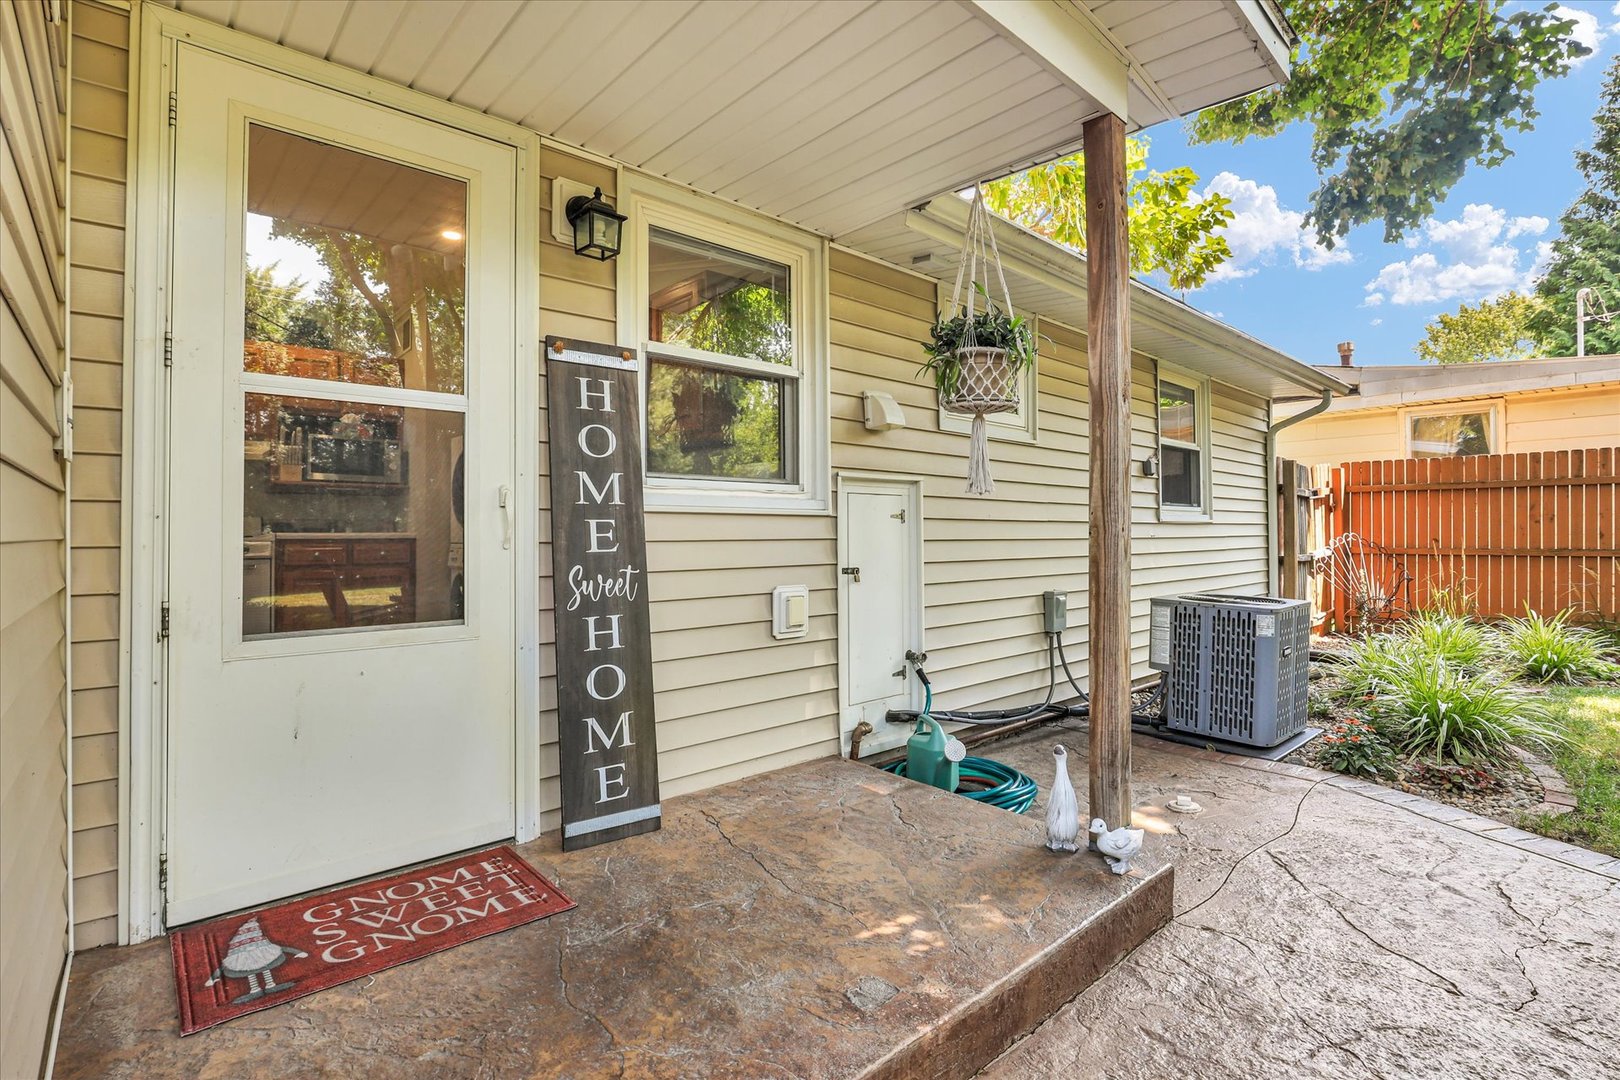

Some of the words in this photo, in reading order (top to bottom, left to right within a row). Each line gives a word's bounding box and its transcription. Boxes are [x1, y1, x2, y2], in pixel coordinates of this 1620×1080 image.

[574, 376, 625, 553] HOME
[567, 565, 640, 611] Sweet
[583, 614, 635, 804] HOME
[303, 857, 512, 924] GNOME
[311, 869, 520, 945] SWEET
[321, 885, 548, 963] GNOME
